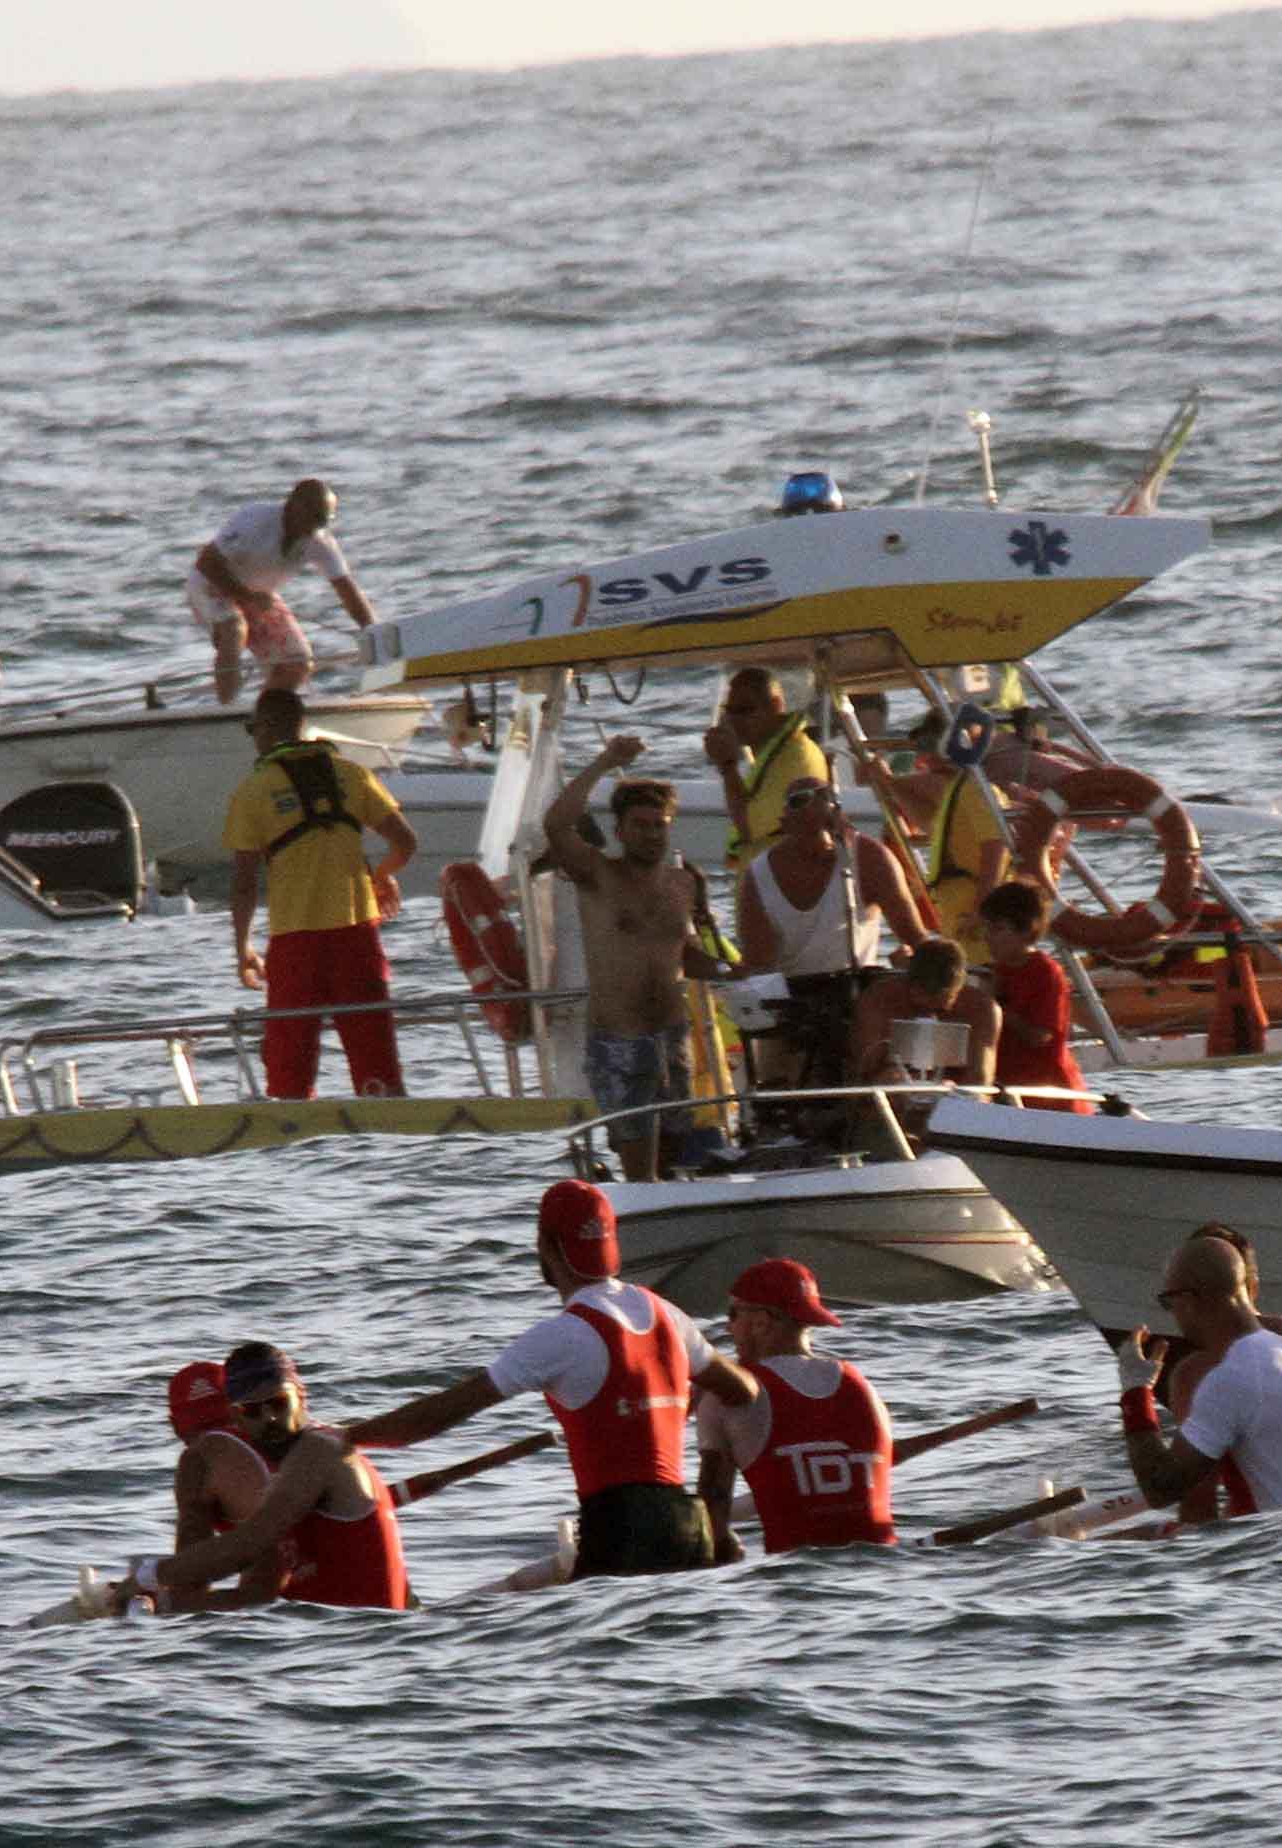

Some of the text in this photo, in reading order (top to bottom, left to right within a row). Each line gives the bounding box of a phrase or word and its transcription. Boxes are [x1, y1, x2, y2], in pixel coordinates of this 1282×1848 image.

[597, 557, 772, 606] SVS
[5, 828, 122, 848] MERCURY
[773, 1440, 888, 1497] TDT
